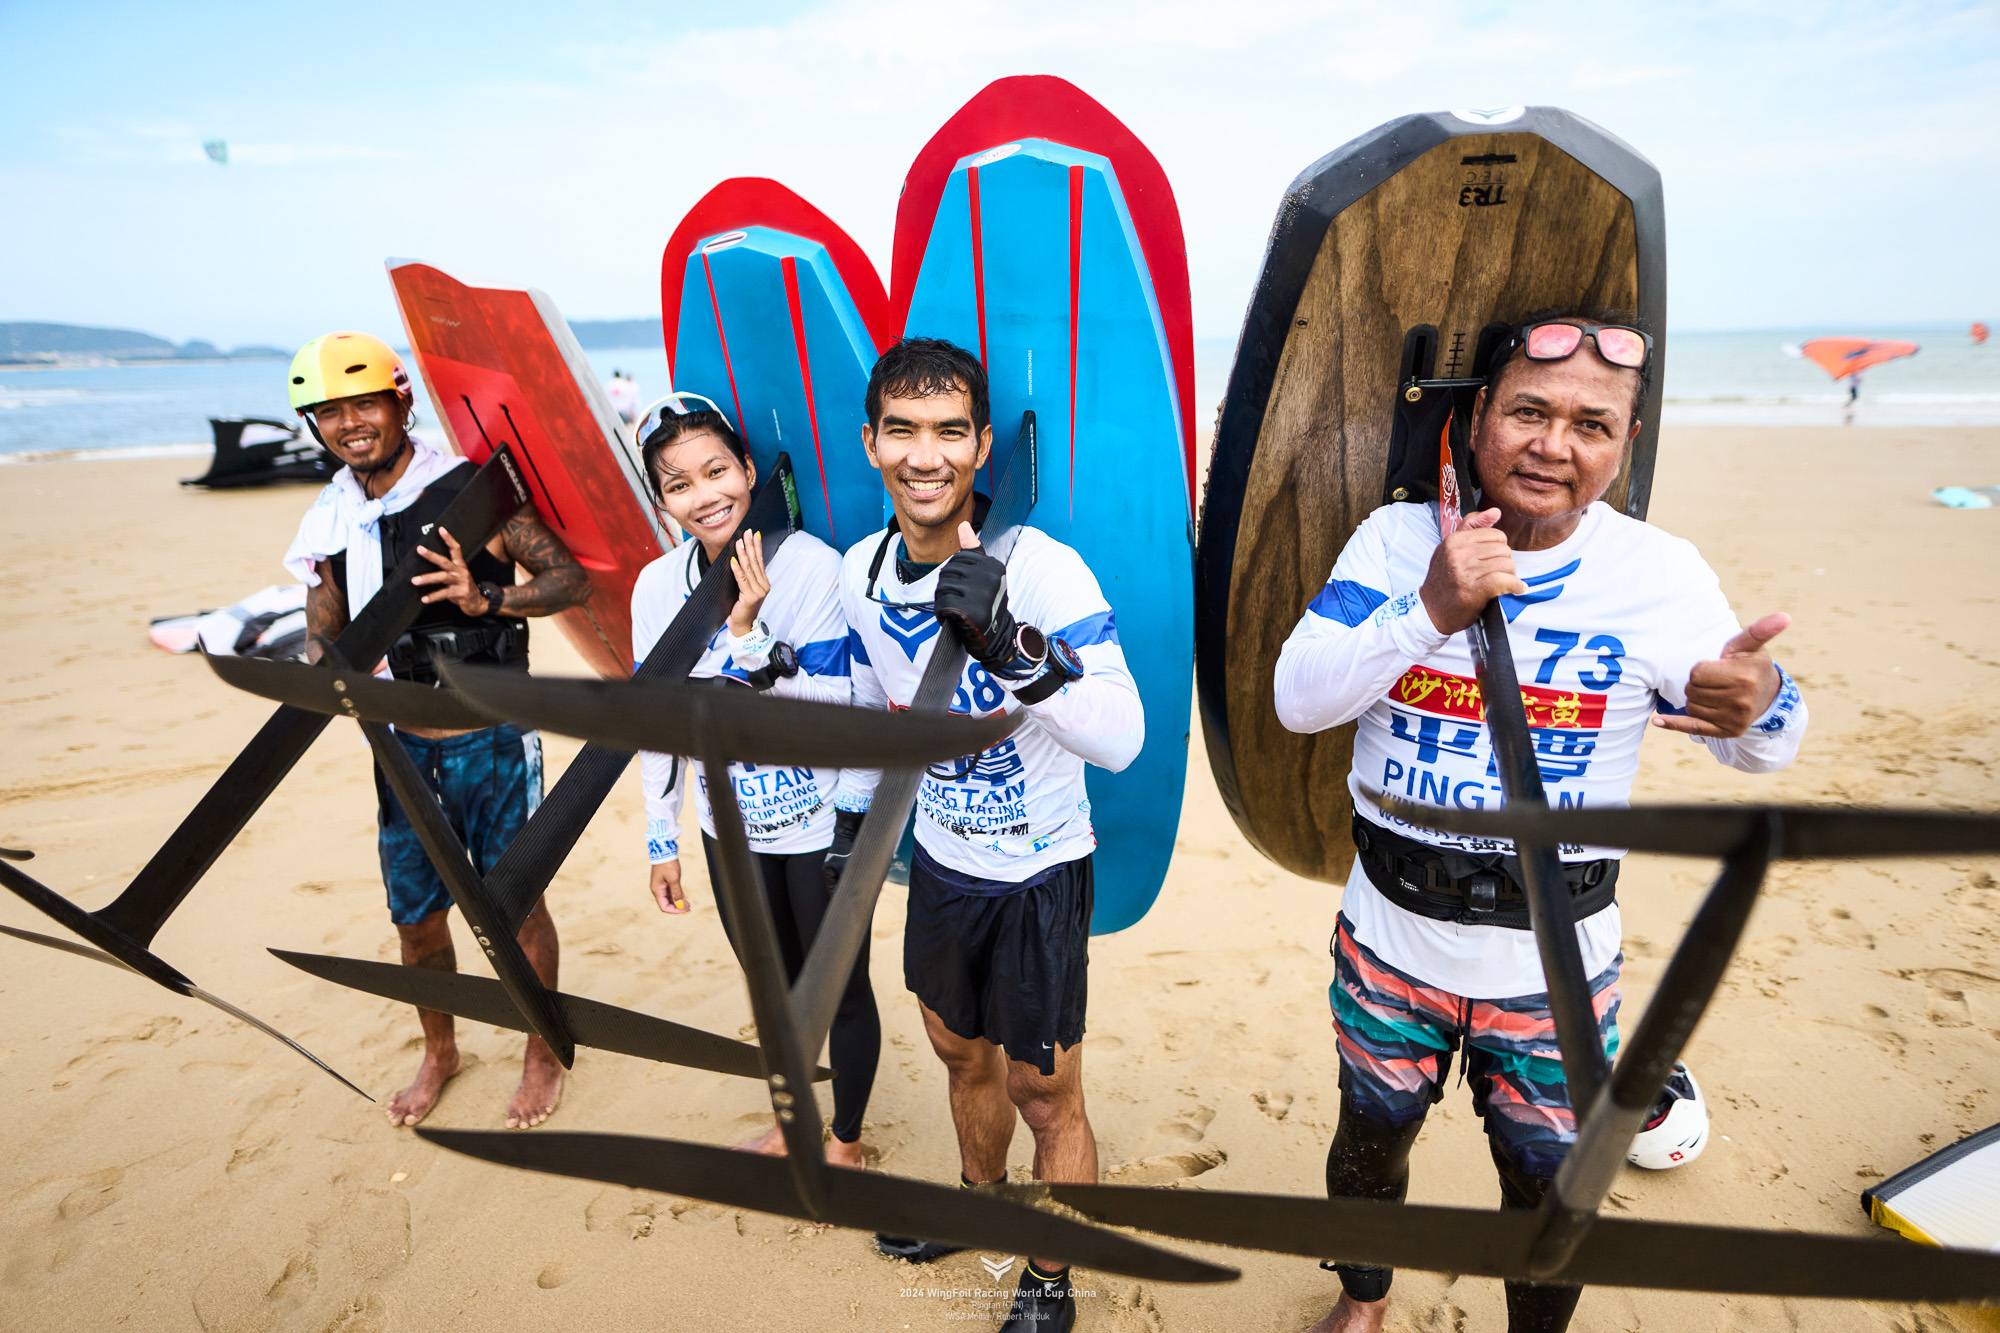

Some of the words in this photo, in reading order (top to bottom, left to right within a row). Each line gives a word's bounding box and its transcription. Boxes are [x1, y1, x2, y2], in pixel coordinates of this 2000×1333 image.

[1459, 185, 1507, 207] TR3
[1534, 627, 1626, 691] 73
[762, 782, 818, 807] RACING
[749, 809, 776, 822] CUP
[780, 794, 821, 815] CHINA
